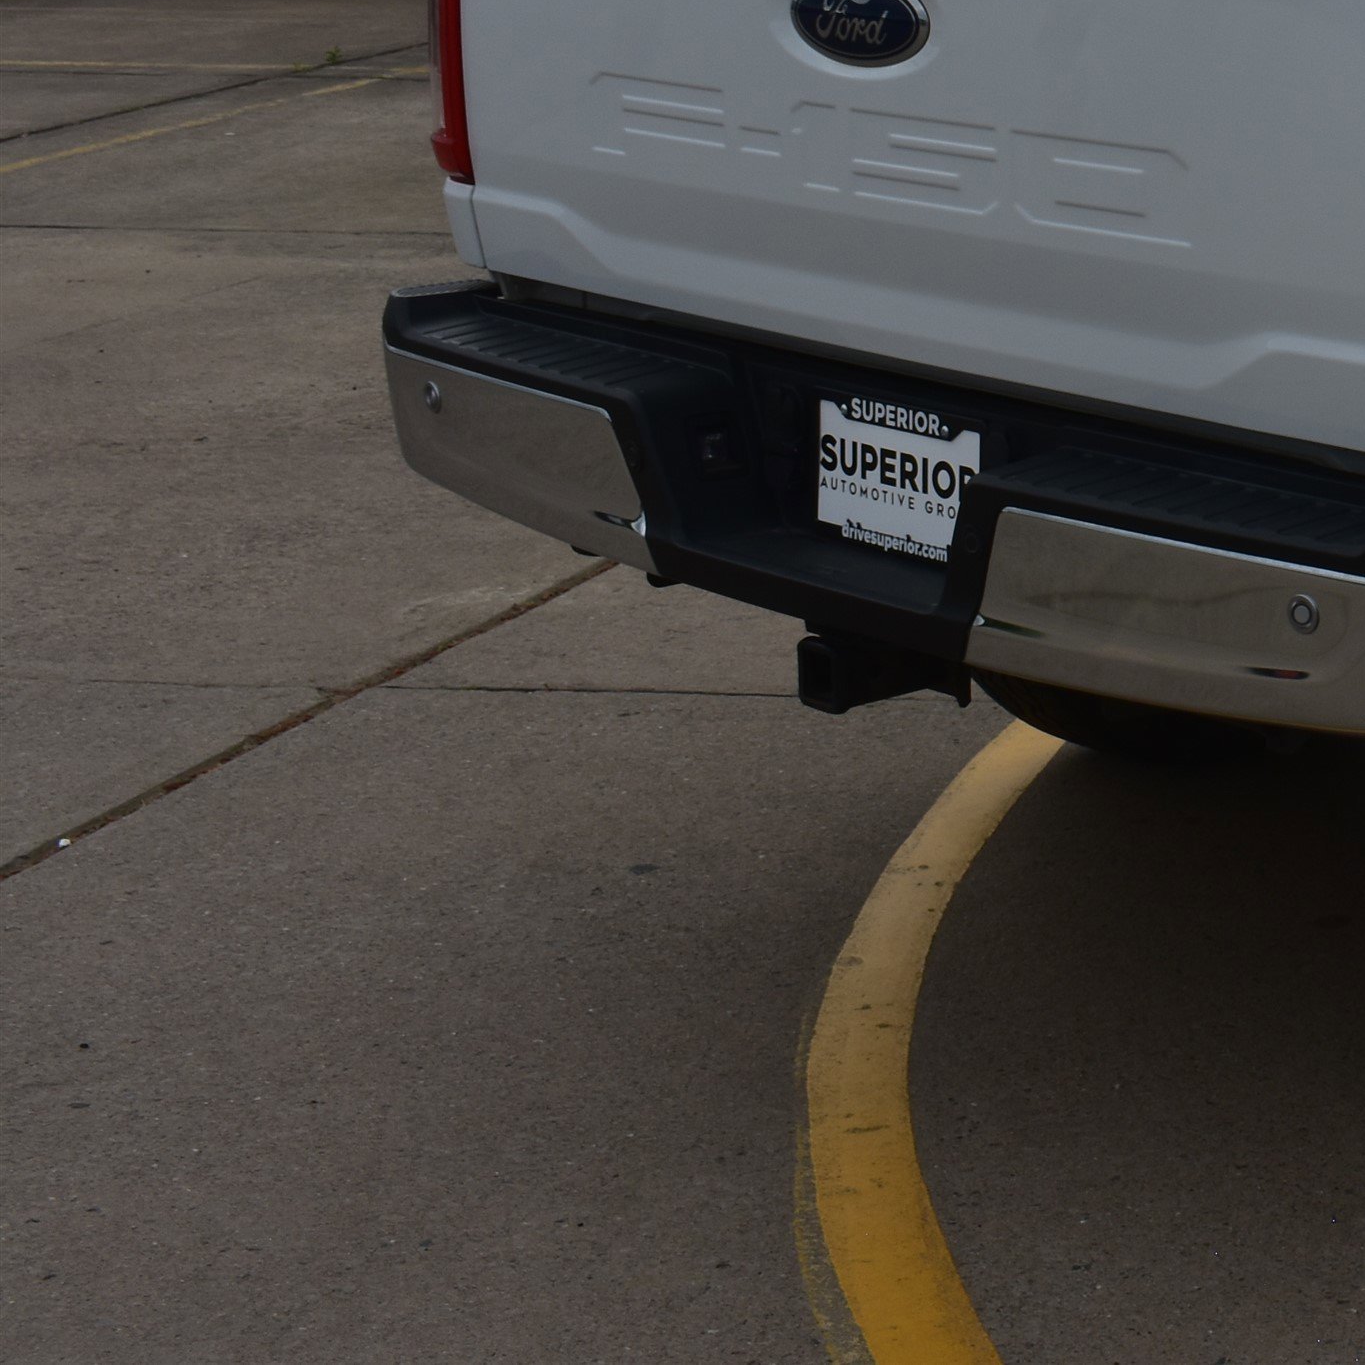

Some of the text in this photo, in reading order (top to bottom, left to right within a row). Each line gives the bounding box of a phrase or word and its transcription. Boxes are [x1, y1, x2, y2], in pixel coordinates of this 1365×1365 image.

[850, 397, 940, 436] SUPERIOR
[820, 476, 957, 520] AUTOMOTIVE GRO
[841, 520, 948, 563] drivesuperior.com
